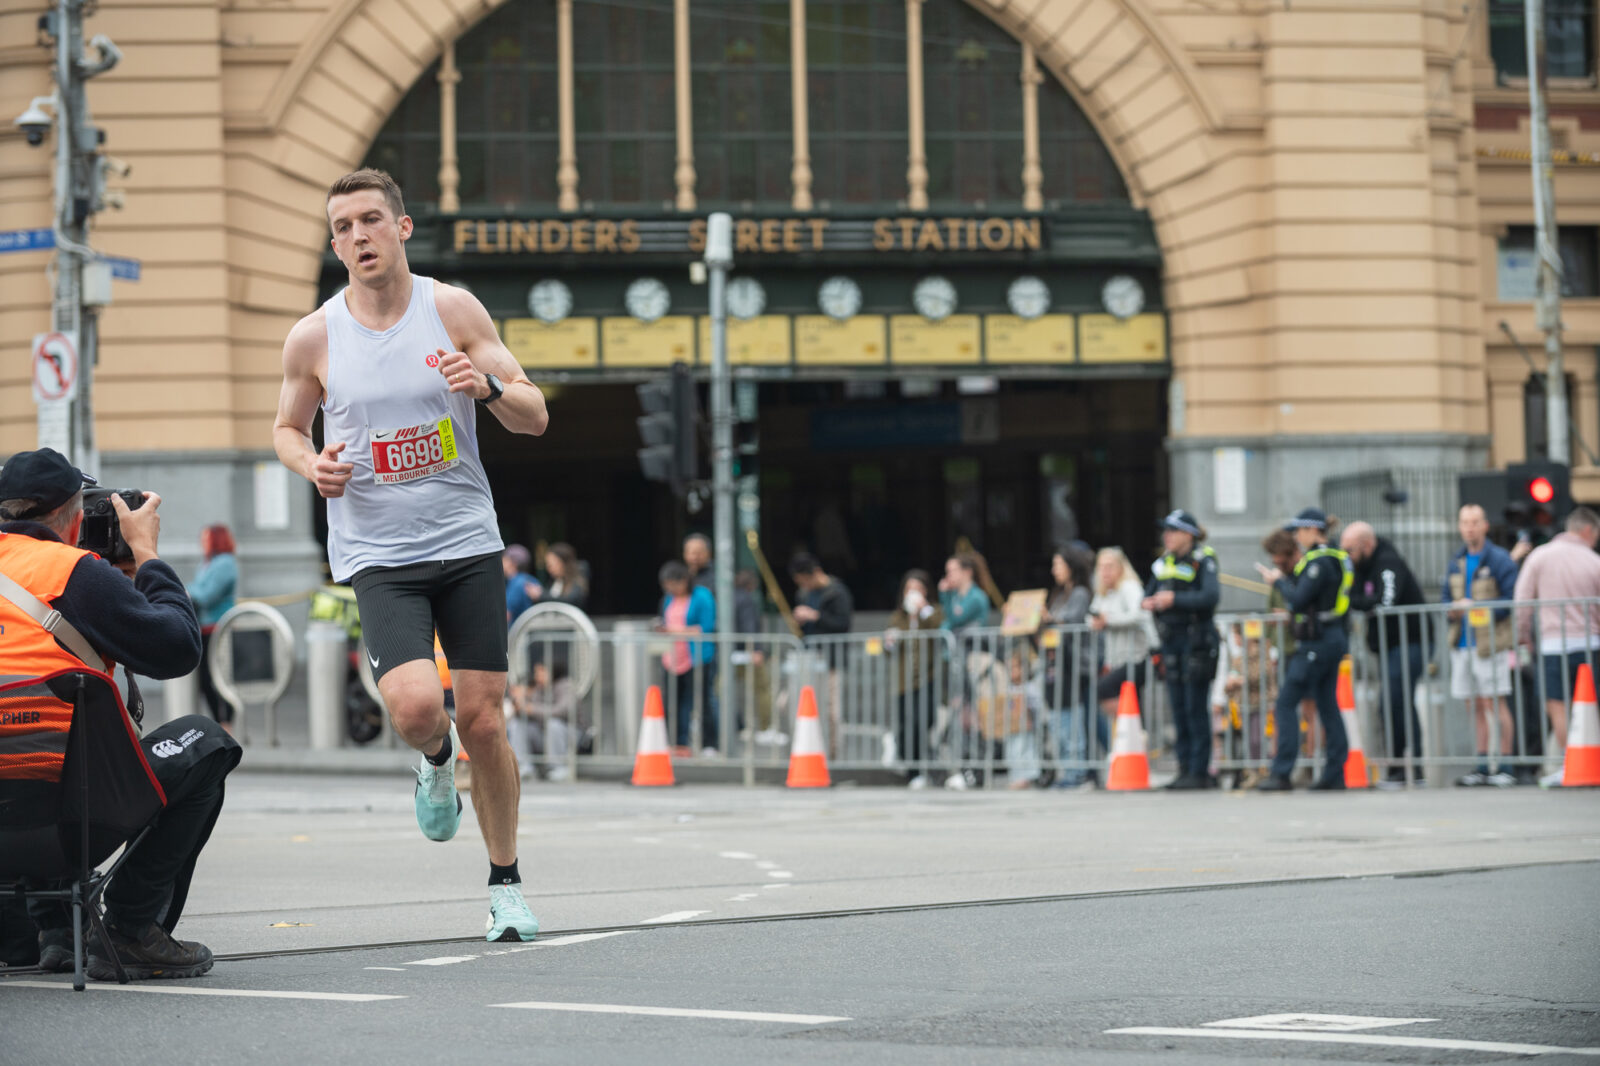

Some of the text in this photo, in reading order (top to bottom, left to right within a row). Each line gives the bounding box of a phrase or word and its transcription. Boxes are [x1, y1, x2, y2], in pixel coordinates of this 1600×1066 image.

[453, 218, 1041, 253] FLINDERS SREET STATION
[386, 434, 443, 471] 6698
[444, 435, 455, 458] ELITE
[382, 461, 452, 483] MELBOURNE 2025
[0, 711, 40, 725] PHER
